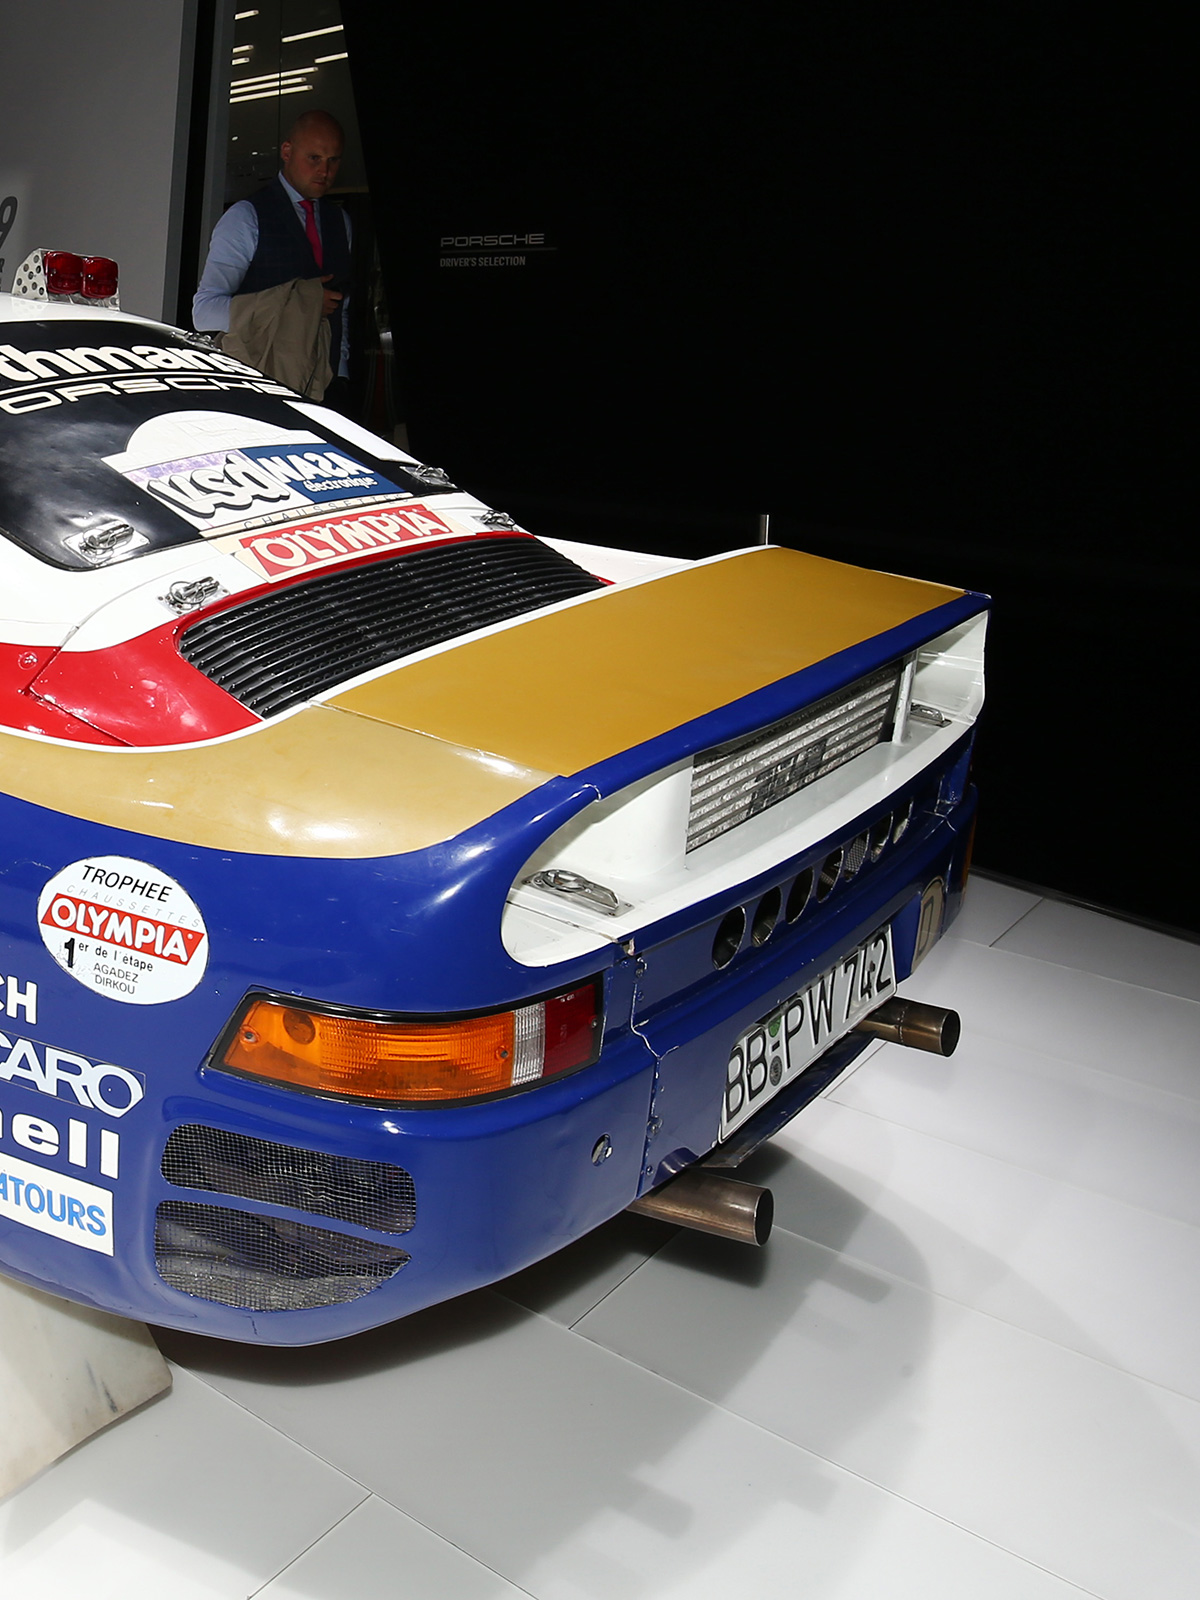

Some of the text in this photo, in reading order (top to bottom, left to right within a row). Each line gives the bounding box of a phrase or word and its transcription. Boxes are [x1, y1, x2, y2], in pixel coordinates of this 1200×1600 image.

[440, 233, 545, 248] PORSCHE
[440, 256, 526, 268] DRIVER'S SELECTION
[249, 509, 451, 568] OLYMPIA
[81, 864, 173, 903] TROPHEE
[66, 884, 201, 929] CHAUSSETTES
[50, 897, 189, 963] OLYMPIA
[93, 961, 140, 984] AGADEZ
[94, 974, 136, 996] DIRKOU
[842, 931, 891, 1021] 742
